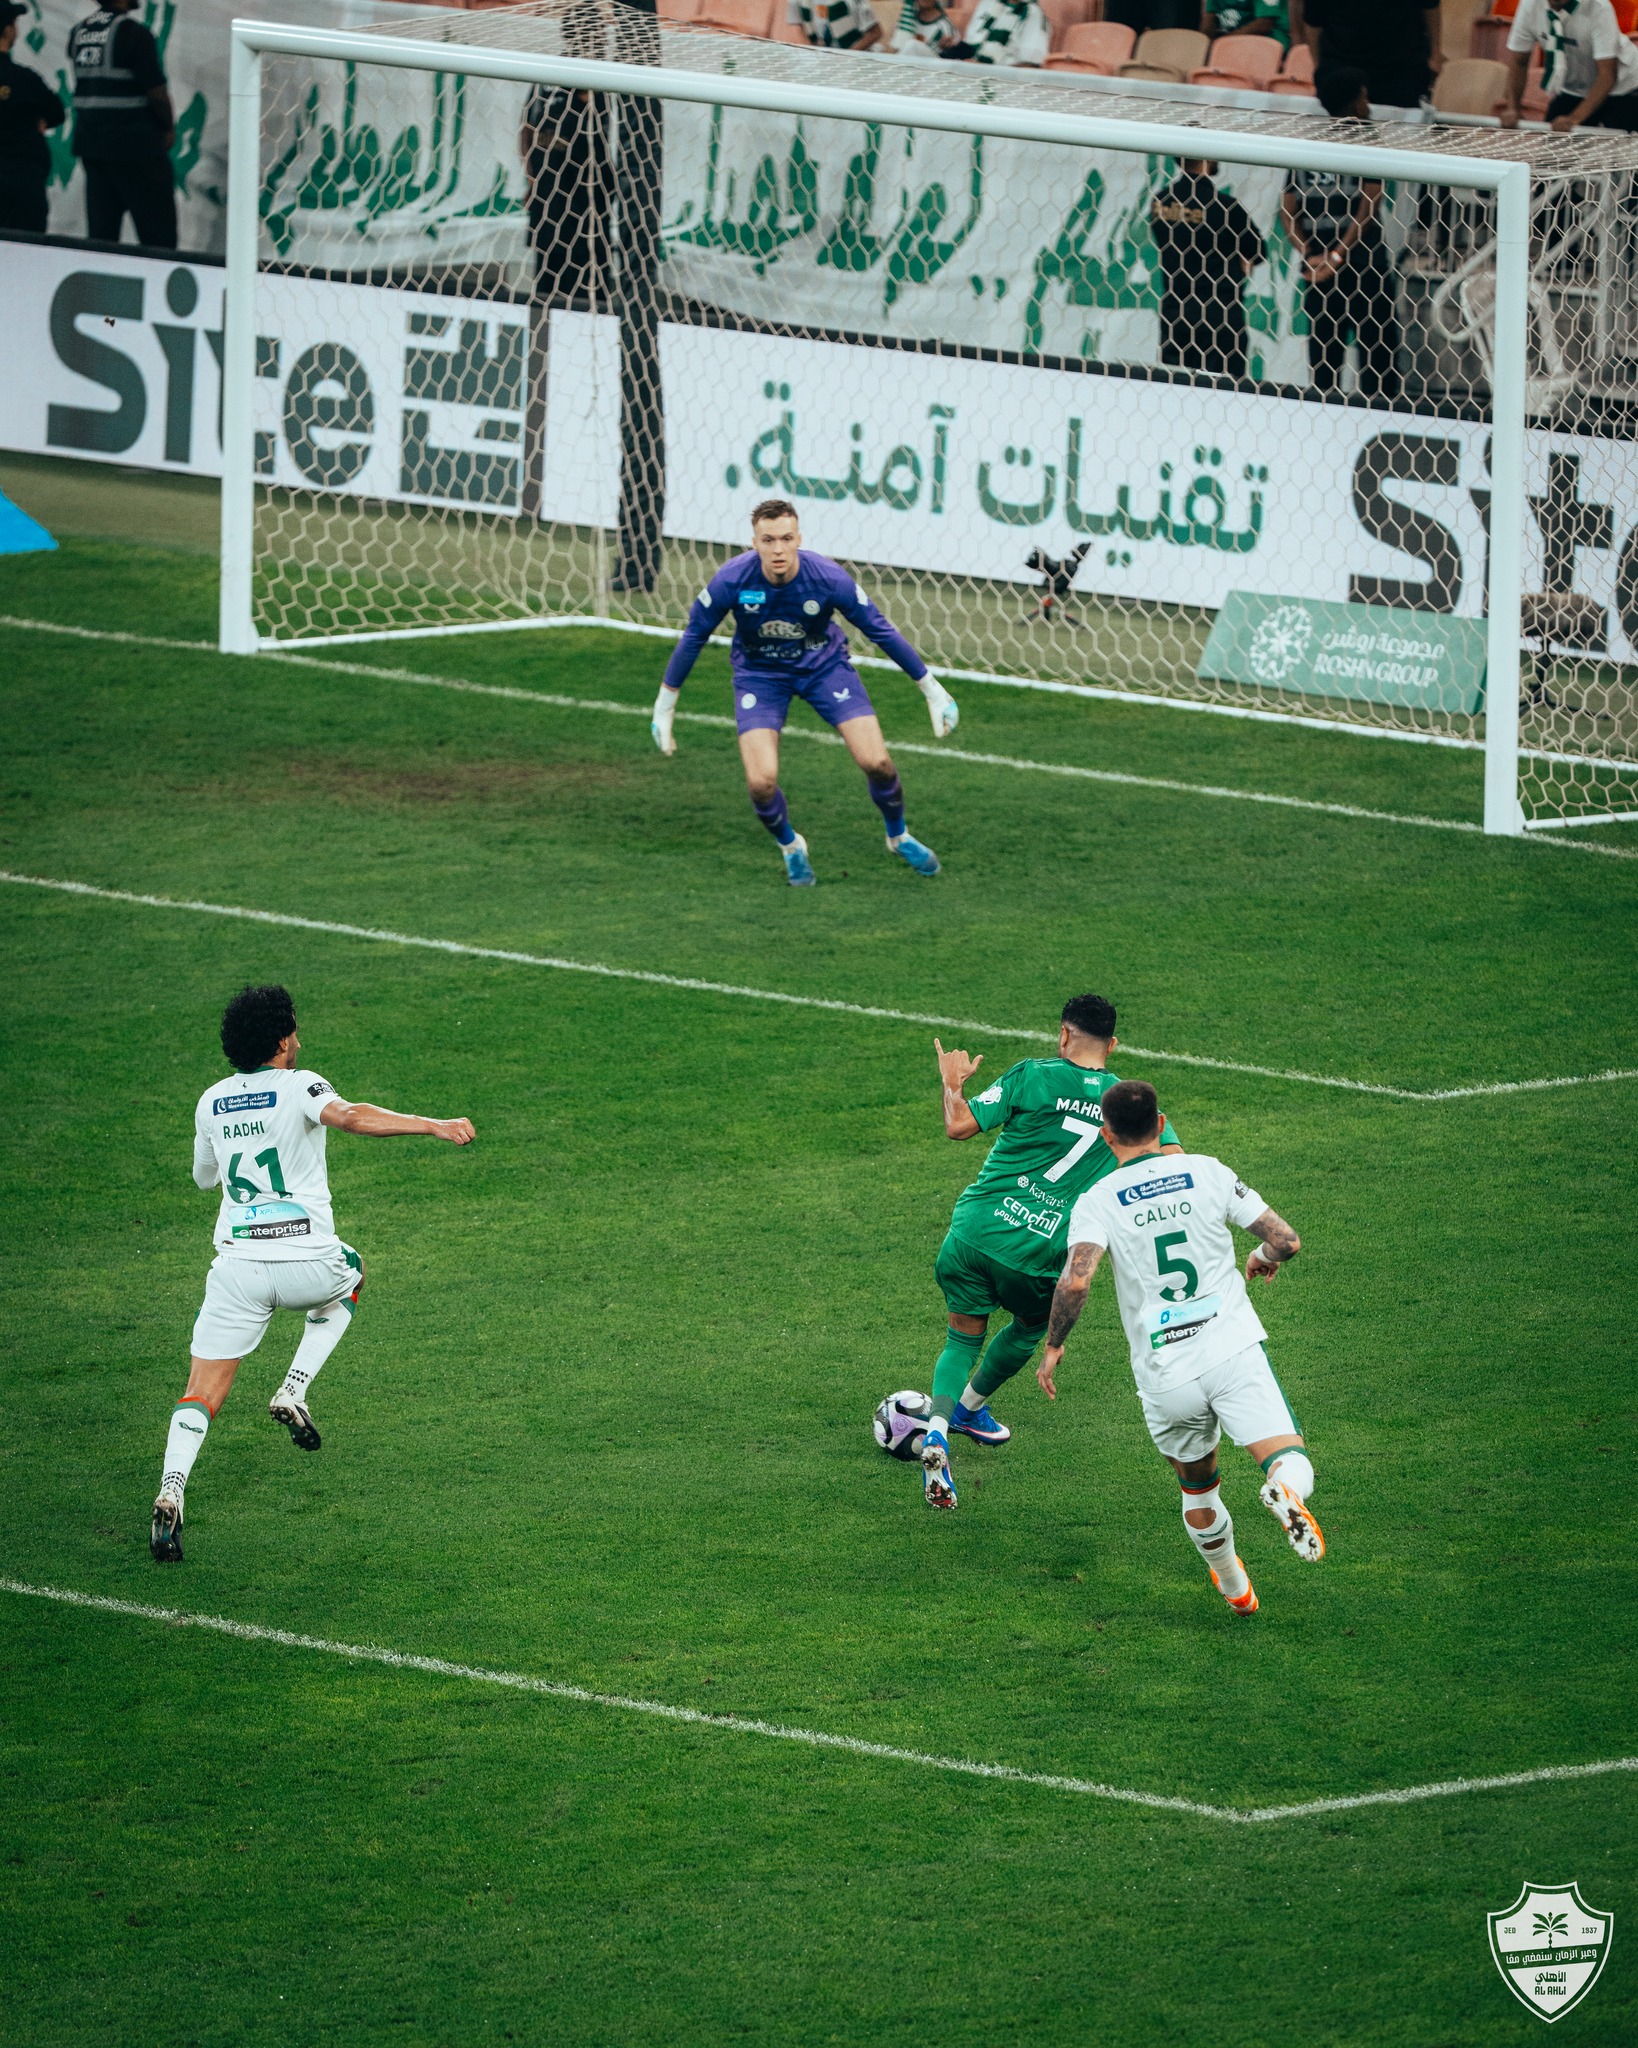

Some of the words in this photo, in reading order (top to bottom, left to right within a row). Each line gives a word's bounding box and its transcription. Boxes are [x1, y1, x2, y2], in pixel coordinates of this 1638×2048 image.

[978, 417, 1268, 567] تقنيات
[1349, 431, 1638, 654] St
[1314, 652, 1375, 680] ROSHN
[1375, 661, 1439, 688] GROUP
[1056, 1098, 1105, 1121] MAHR
[223, 1120, 265, 1139] RADHI
[1043, 1115, 1100, 1183] 7
[226, 1147, 293, 1204] 61
[235, 1223, 307, 1238] enterprise
[1134, 1201, 1192, 1227] CALVO
[1154, 1230, 1199, 1302] 5
[1153, 1322, 1206, 1343] enterpr
